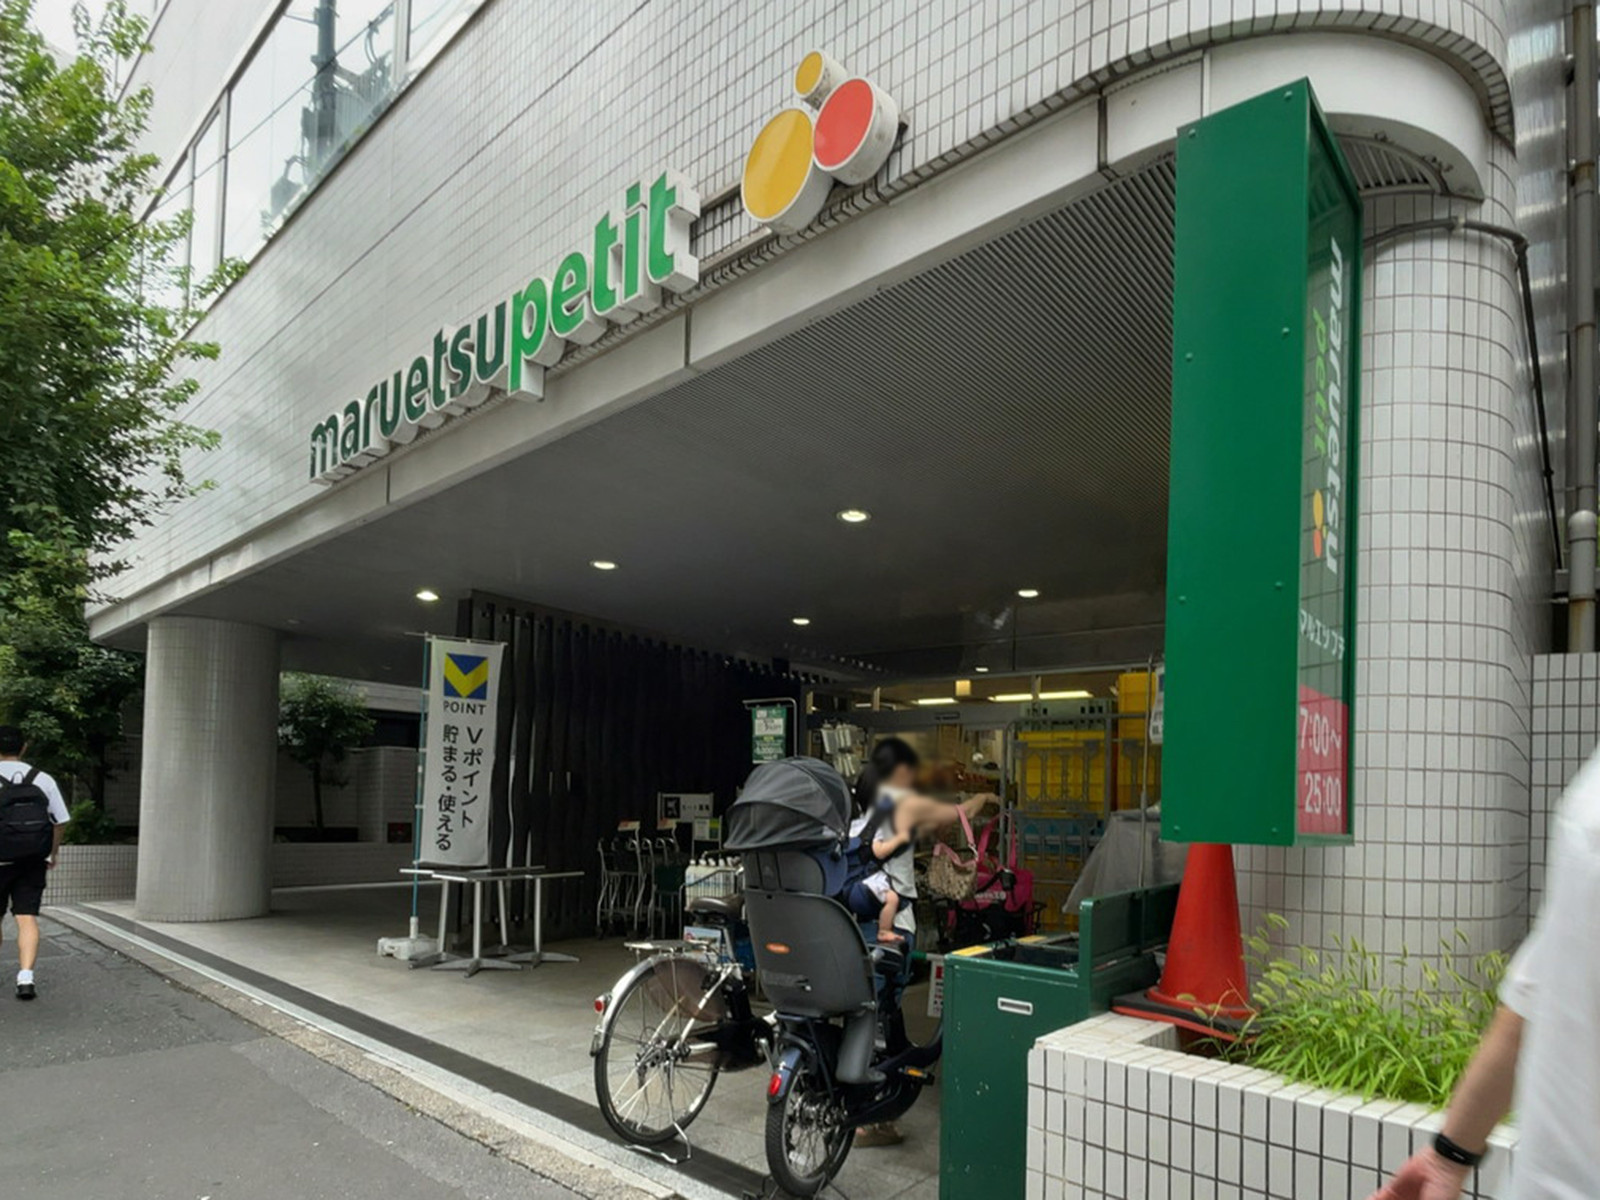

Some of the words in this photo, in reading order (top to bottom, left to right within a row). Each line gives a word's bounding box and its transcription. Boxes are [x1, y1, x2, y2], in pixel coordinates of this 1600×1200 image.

[1312, 307, 1328, 456] petit
[1326, 236, 1344, 575] maruetsu
[443, 701, 487, 715] POINT
[436, 724, 459, 851] 貯まる・使える
[461, 726, 484, 828] Vポイント
[1305, 772, 1342, 817] 25:00
